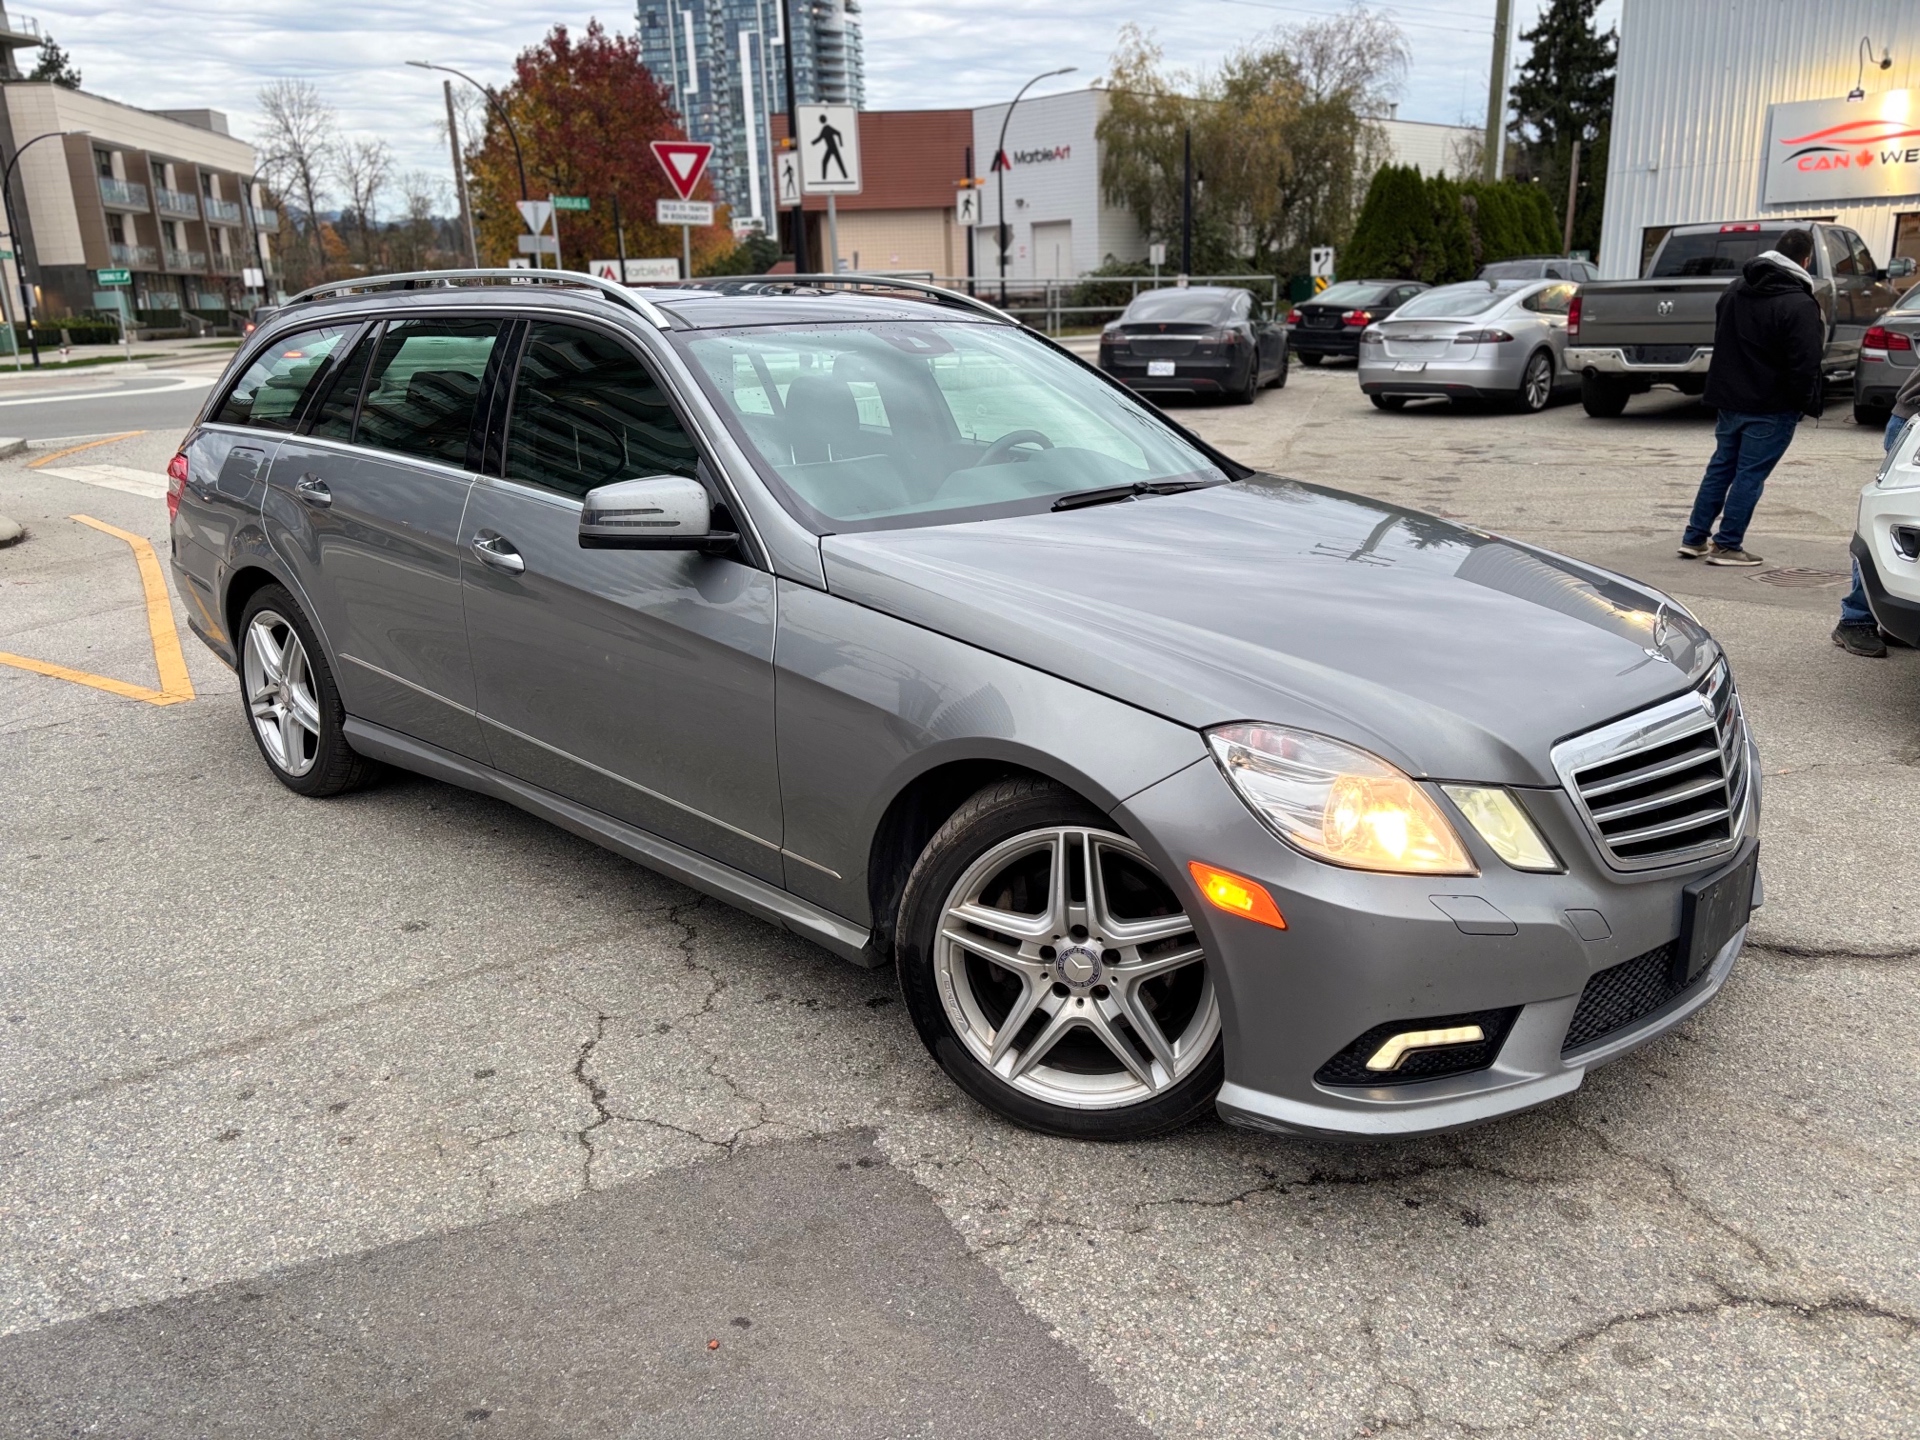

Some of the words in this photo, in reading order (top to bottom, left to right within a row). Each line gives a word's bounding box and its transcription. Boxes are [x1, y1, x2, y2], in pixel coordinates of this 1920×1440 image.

[1013, 144, 1071, 165] MarbleArt
[1797, 153, 1851, 172] CAN
[679, 204, 687, 212] TO
[671, 213, 710, 221] ROUNDABOUT
